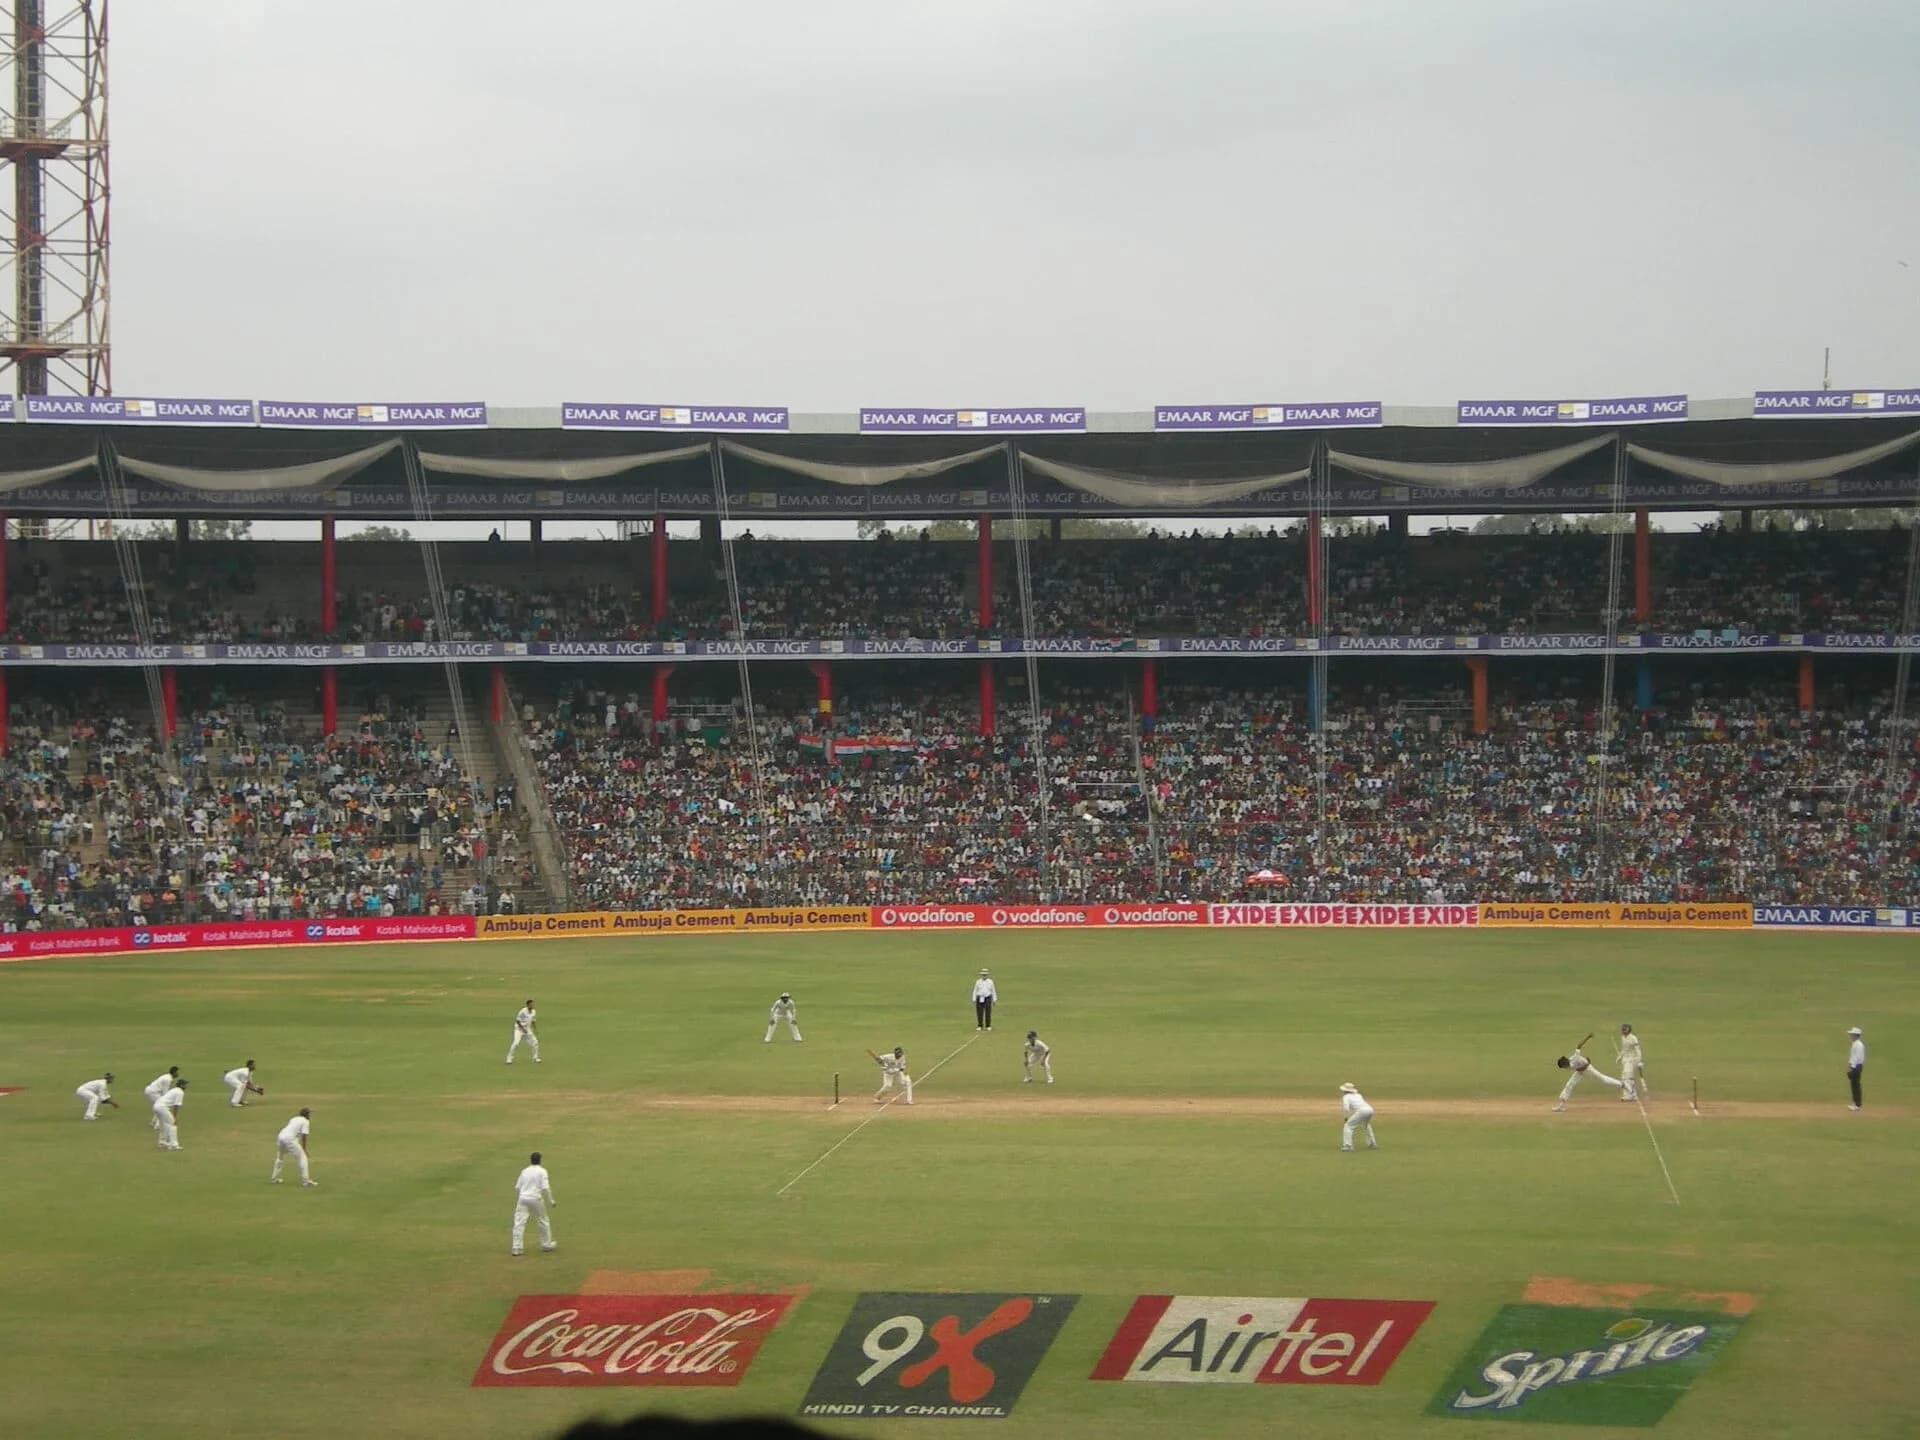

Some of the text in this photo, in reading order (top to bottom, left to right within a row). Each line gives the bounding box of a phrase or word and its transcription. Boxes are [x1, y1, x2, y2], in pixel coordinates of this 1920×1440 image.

[1755, 396, 1849, 408] EMAAR MGF
[1887, 395, 1920, 406] EMA
[0, 402, 12, 414] GF
[29, 402, 124, 415] EMAAR MGF
[158, 403, 252, 416] EMAAR MGF
[262, 406, 356, 420] EMAAR MGF
[390, 407, 484, 420] EMAAR MGF
[1285, 406, 1379, 420] EMAAR MGF
[1460, 406, 1555, 417] EMAAR MGF
[1591, 401, 1687, 416] EMAAR MGF
[564, 408, 658, 422] EMAAR MGF
[692, 412, 786, 424] EMAAR MGF
[862, 413, 956, 425] EMAAR MGF
[989, 412, 1083, 425] EMAAR MGF
[1157, 410, 1251, 423] EMAAR MGF
[18, 491, 70, 500] EMAAR
[353, 494, 404, 503] EMAAR
[447, 493, 533, 504] EMAAR MGF
[660, 493, 710, 503] EMAAR
[872, 493, 957, 504] EMAAR MGF
[1045, 493, 1074, 503] MGF
[1348, 491, 1377, 500] MGF
[1412, 489, 1464, 498] EMAAR
[1503, 487, 1593, 498] EMAAR MGF
[566, 494, 652, 504] EMAAR MGF
[779, 495, 864, 505] EMAAR MGF
[932, 640, 967, 652] MGF
[1022, 639, 1083, 651] EMAAR
[1181, 639, 1284, 651] EMAAR MGF
[1339, 637, 1444, 649] EMAAR MGF
[1500, 636, 1606, 648] EMAAR MGF
[1662, 635, 1723, 647] EMAAR
[1825, 635, 1920, 647] EMAAR MG
[65, 646, 171, 658] EMAAR MGF
[227, 646, 331, 657] EMAAR MGF
[456, 644, 492, 656] MGF
[548, 643, 651, 655] EMAAR MGF
[706, 641, 809, 654] EMAAR MGF
[744, 910, 867, 926] Ambuja Cement
[901, 908, 976, 923] vodafone
[1009, 908, 1086, 923] vodafone
[1119, 907, 1198, 922] vodafone
[1213, 905, 1478, 924] EXIDE EXIDE EXIDE EXIDE
[1484, 906, 1611, 922] Ambuja Cement
[1621, 907, 1747, 923] Ambuja Cement
[1754, 908, 1871, 924] EMAAR MGF
[484, 917, 606, 934] Ambuja Cement
[613, 912, 735, 930] Ambuja Cement
[203, 928, 294, 942] Kotak Mahindra Bank
[326, 923, 361, 936] kotak
[376, 923, 466, 935] Kotak Mahindra Bank
[57, 937, 97, 949] Mahindra
[99, 936, 120, 947] Bank
[153, 931, 187, 943] kotak
[1139, 1313, 1394, 1376] Airtel
[1453, 1318, 1706, 1409] Sprite
[803, 1404, 1006, 1416] HINDI TV CHANNEL
